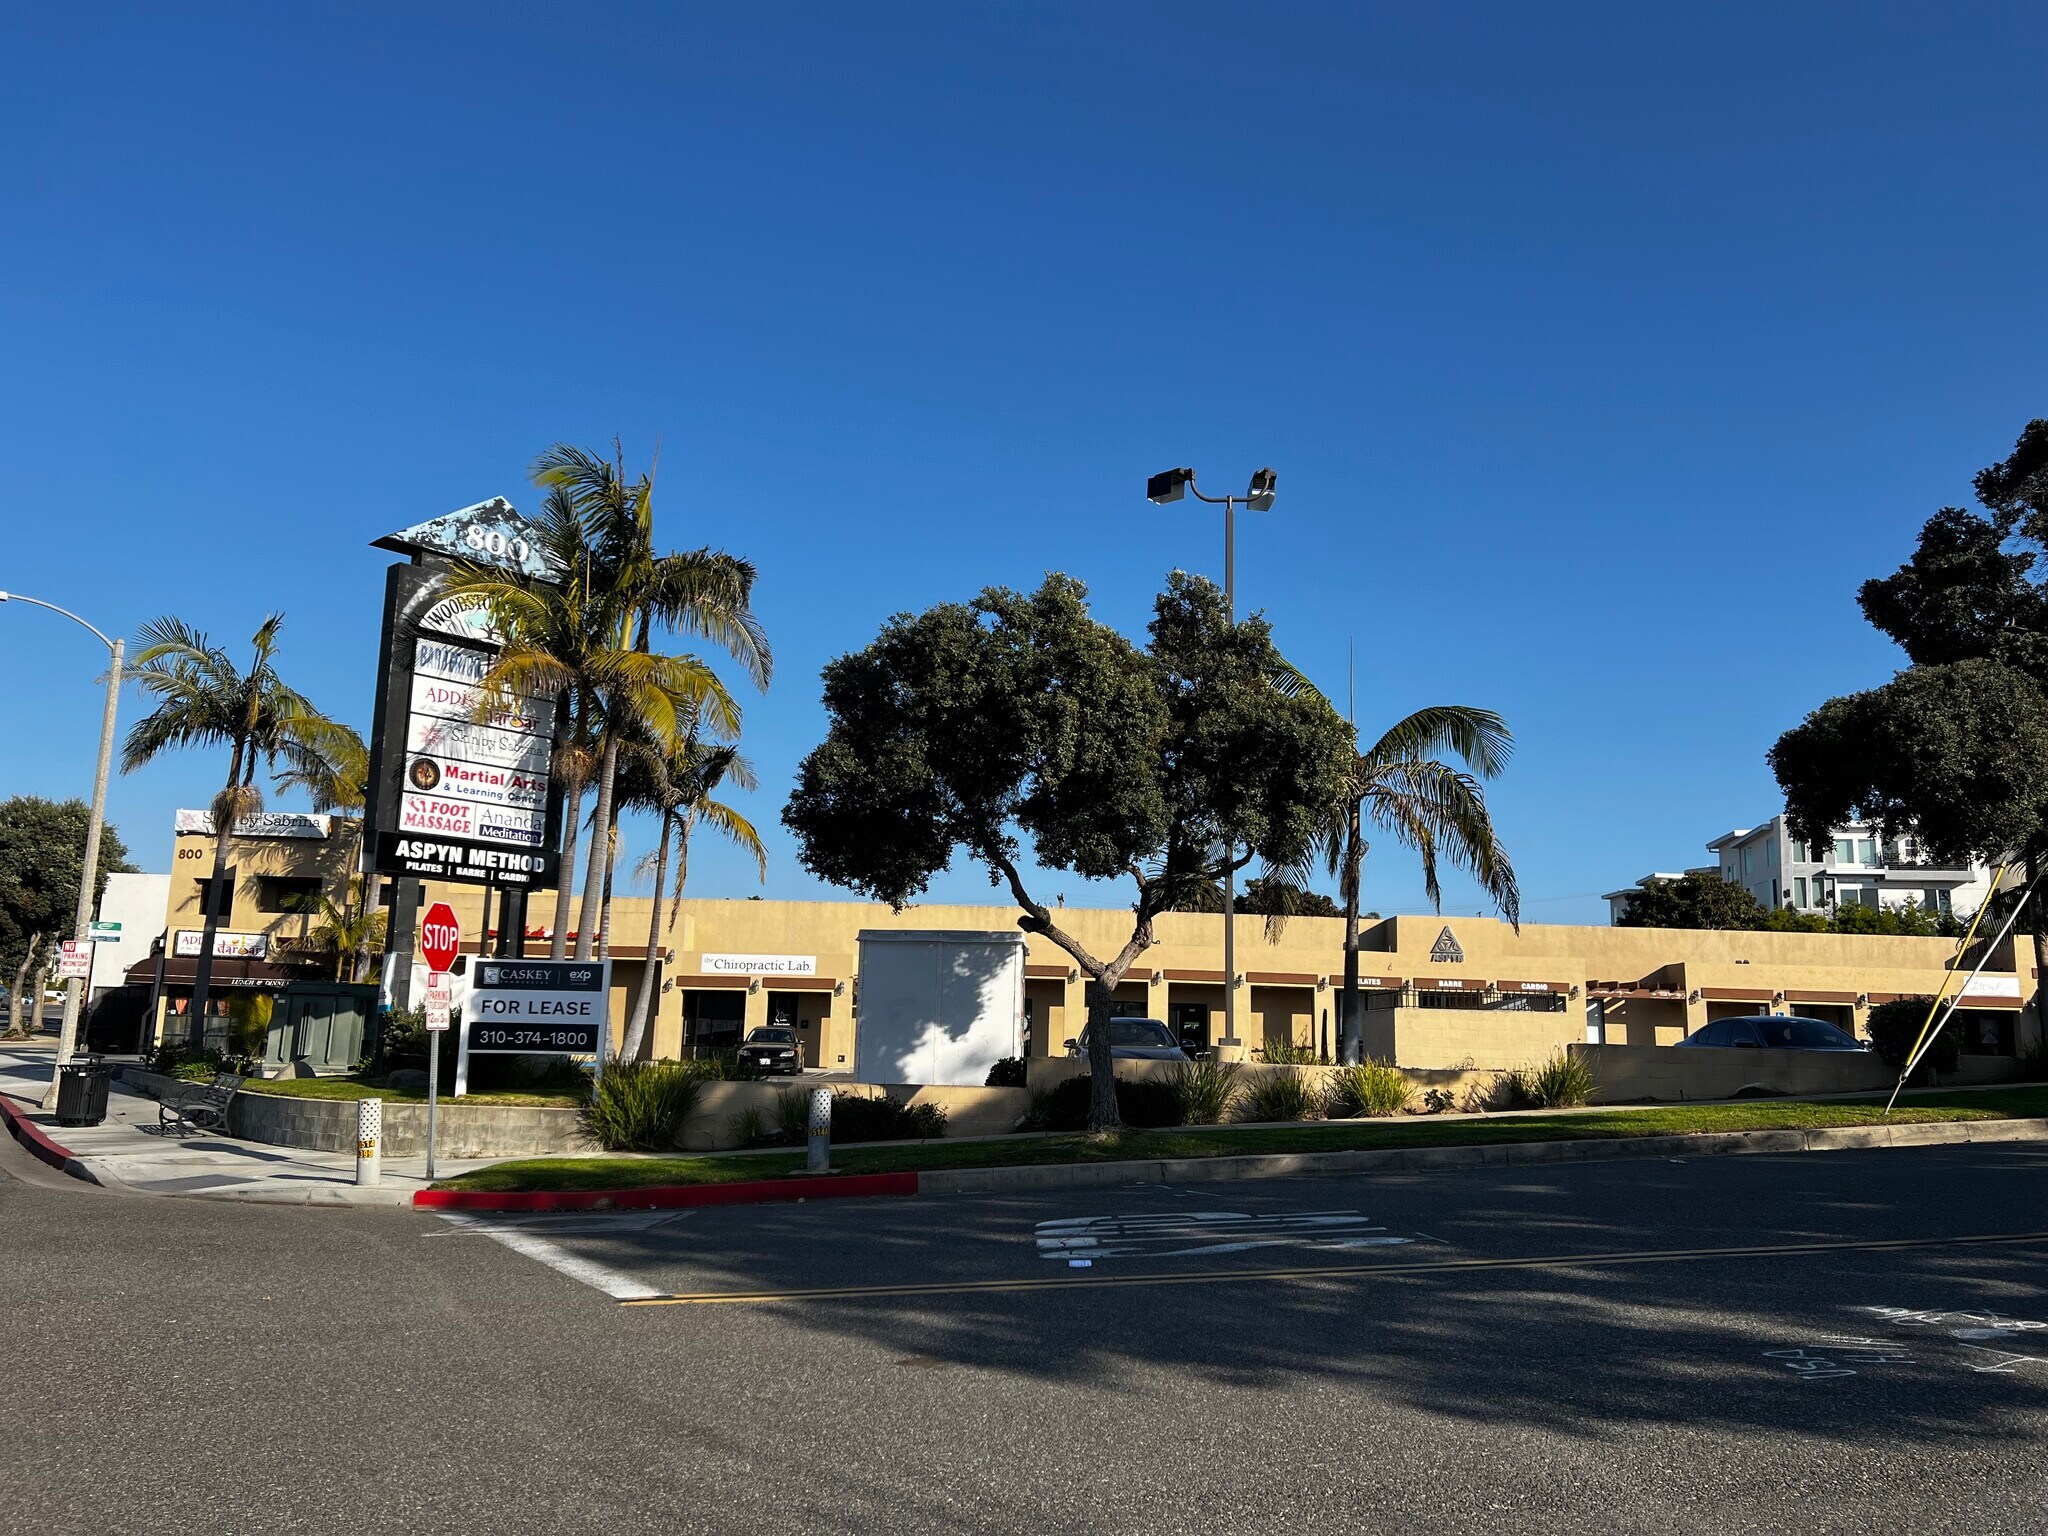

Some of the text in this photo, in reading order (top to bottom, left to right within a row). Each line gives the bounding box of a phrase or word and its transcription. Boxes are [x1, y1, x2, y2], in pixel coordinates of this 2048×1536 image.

[466, 524, 529, 562] 800
[445, 765, 547, 793] Martial Arts
[443, 783, 543, 805] & Learning Center
[430, 801, 470, 817] FOOT
[263, 813, 321, 829] Sabrina
[404, 813, 471, 833] MASSAGE
[480, 808, 543, 831] Ananda
[482, 826, 539, 843] Meditation
[178, 849, 203, 860] 800
[396, 840, 546, 873] ASPYN METHOD
[405, 861, 530, 883] PILATES BARRE CARDIO
[424, 923, 458, 951] STOP
[64, 943, 75, 951] NO
[714, 958, 785, 972] Chiropractic
[788, 960, 812, 972] Lab.
[500, 969, 552, 980] CASKEY
[1438, 980, 1463, 988] BARRE
[1521, 982, 1548, 990] CARDIO
[481, 1000, 592, 1015] FOR LEASE
[479, 1030, 588, 1045] 310-374-1800
